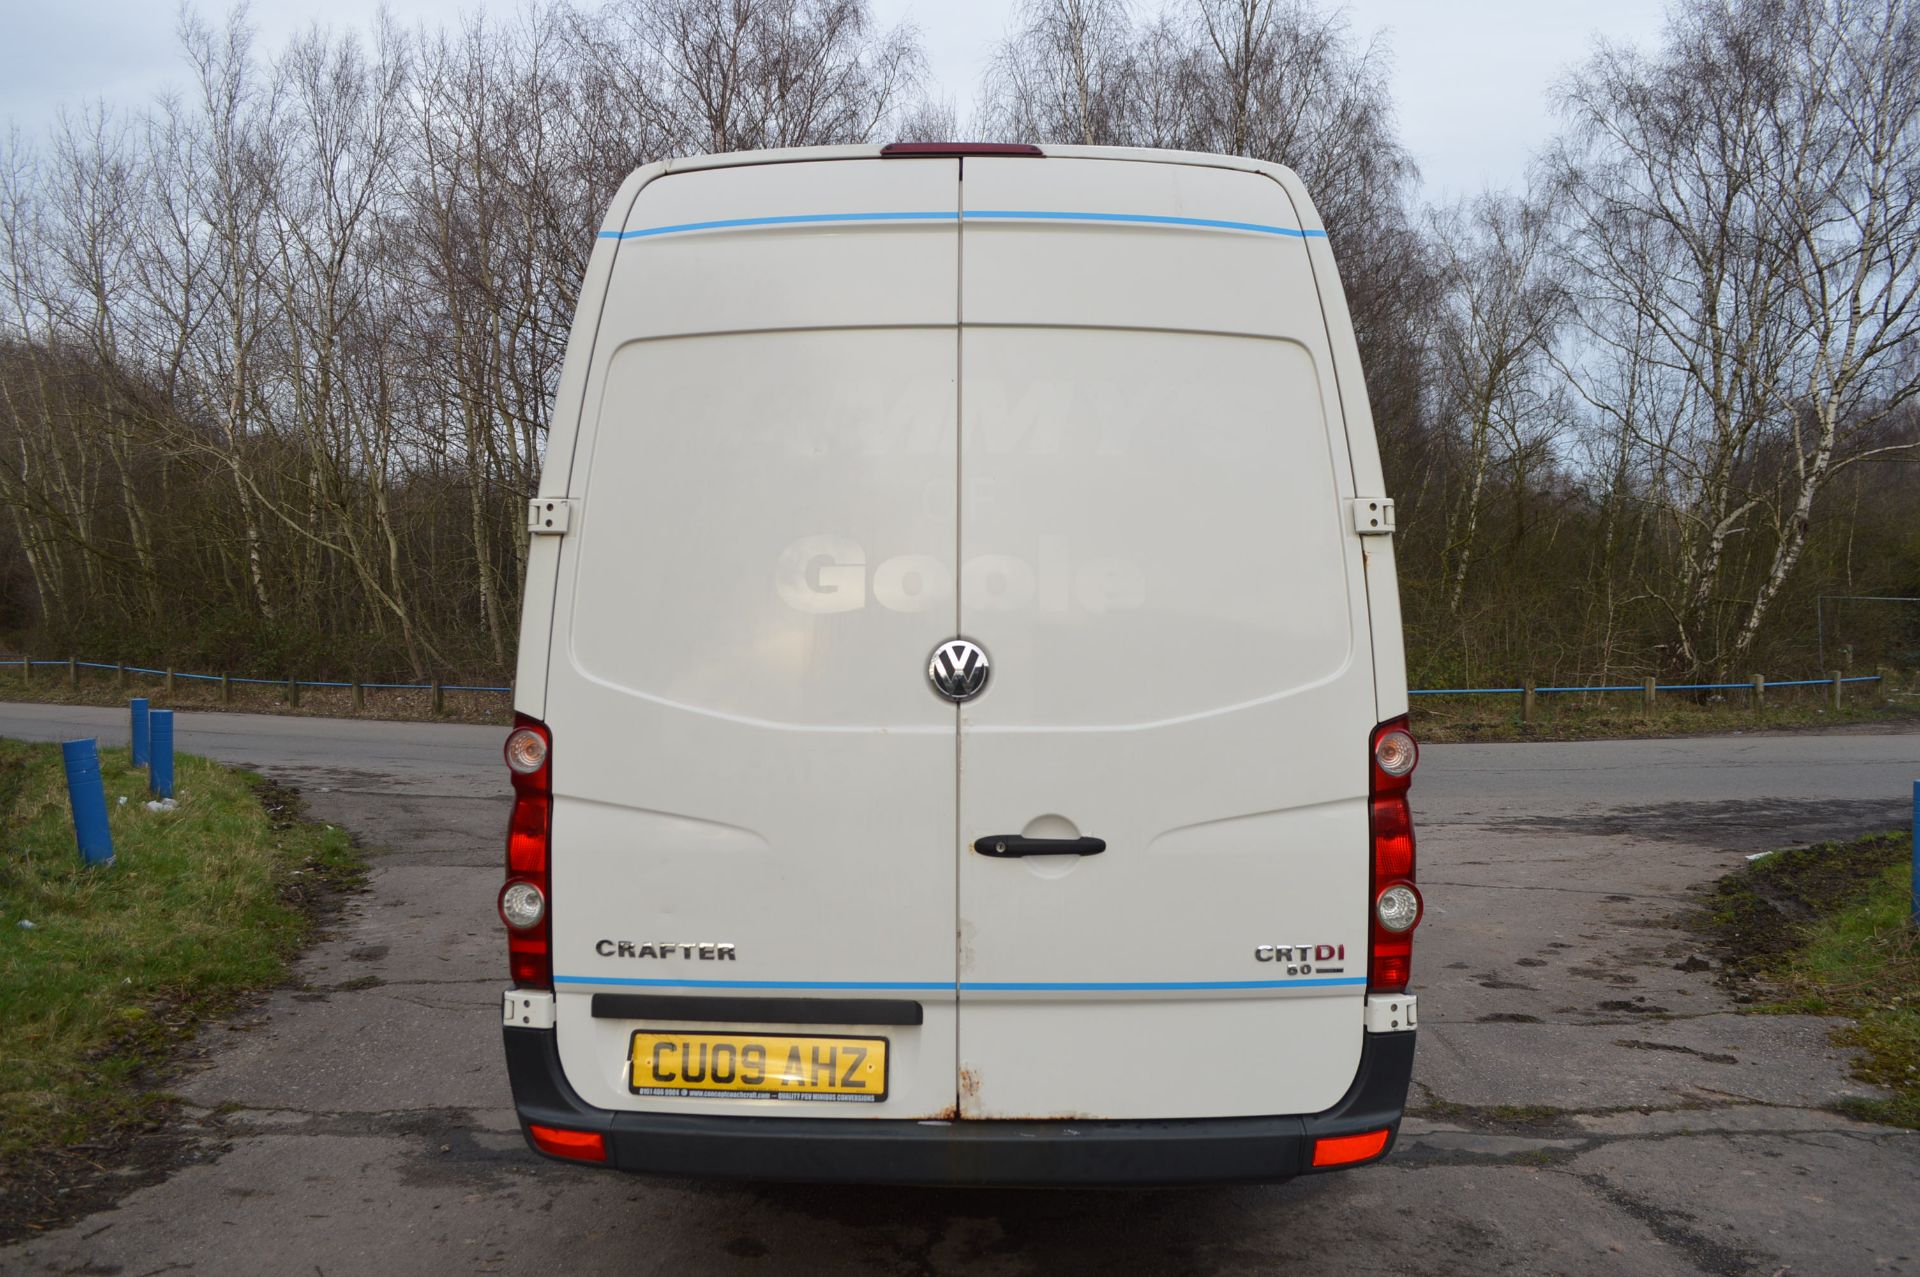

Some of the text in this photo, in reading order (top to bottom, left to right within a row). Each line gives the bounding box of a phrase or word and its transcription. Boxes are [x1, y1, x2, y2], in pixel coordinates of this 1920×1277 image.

[775, 533, 1146, 614] Goole
[595, 939, 736, 961] CRAFTER
[652, 1041, 868, 1088] CU09 AHZ
